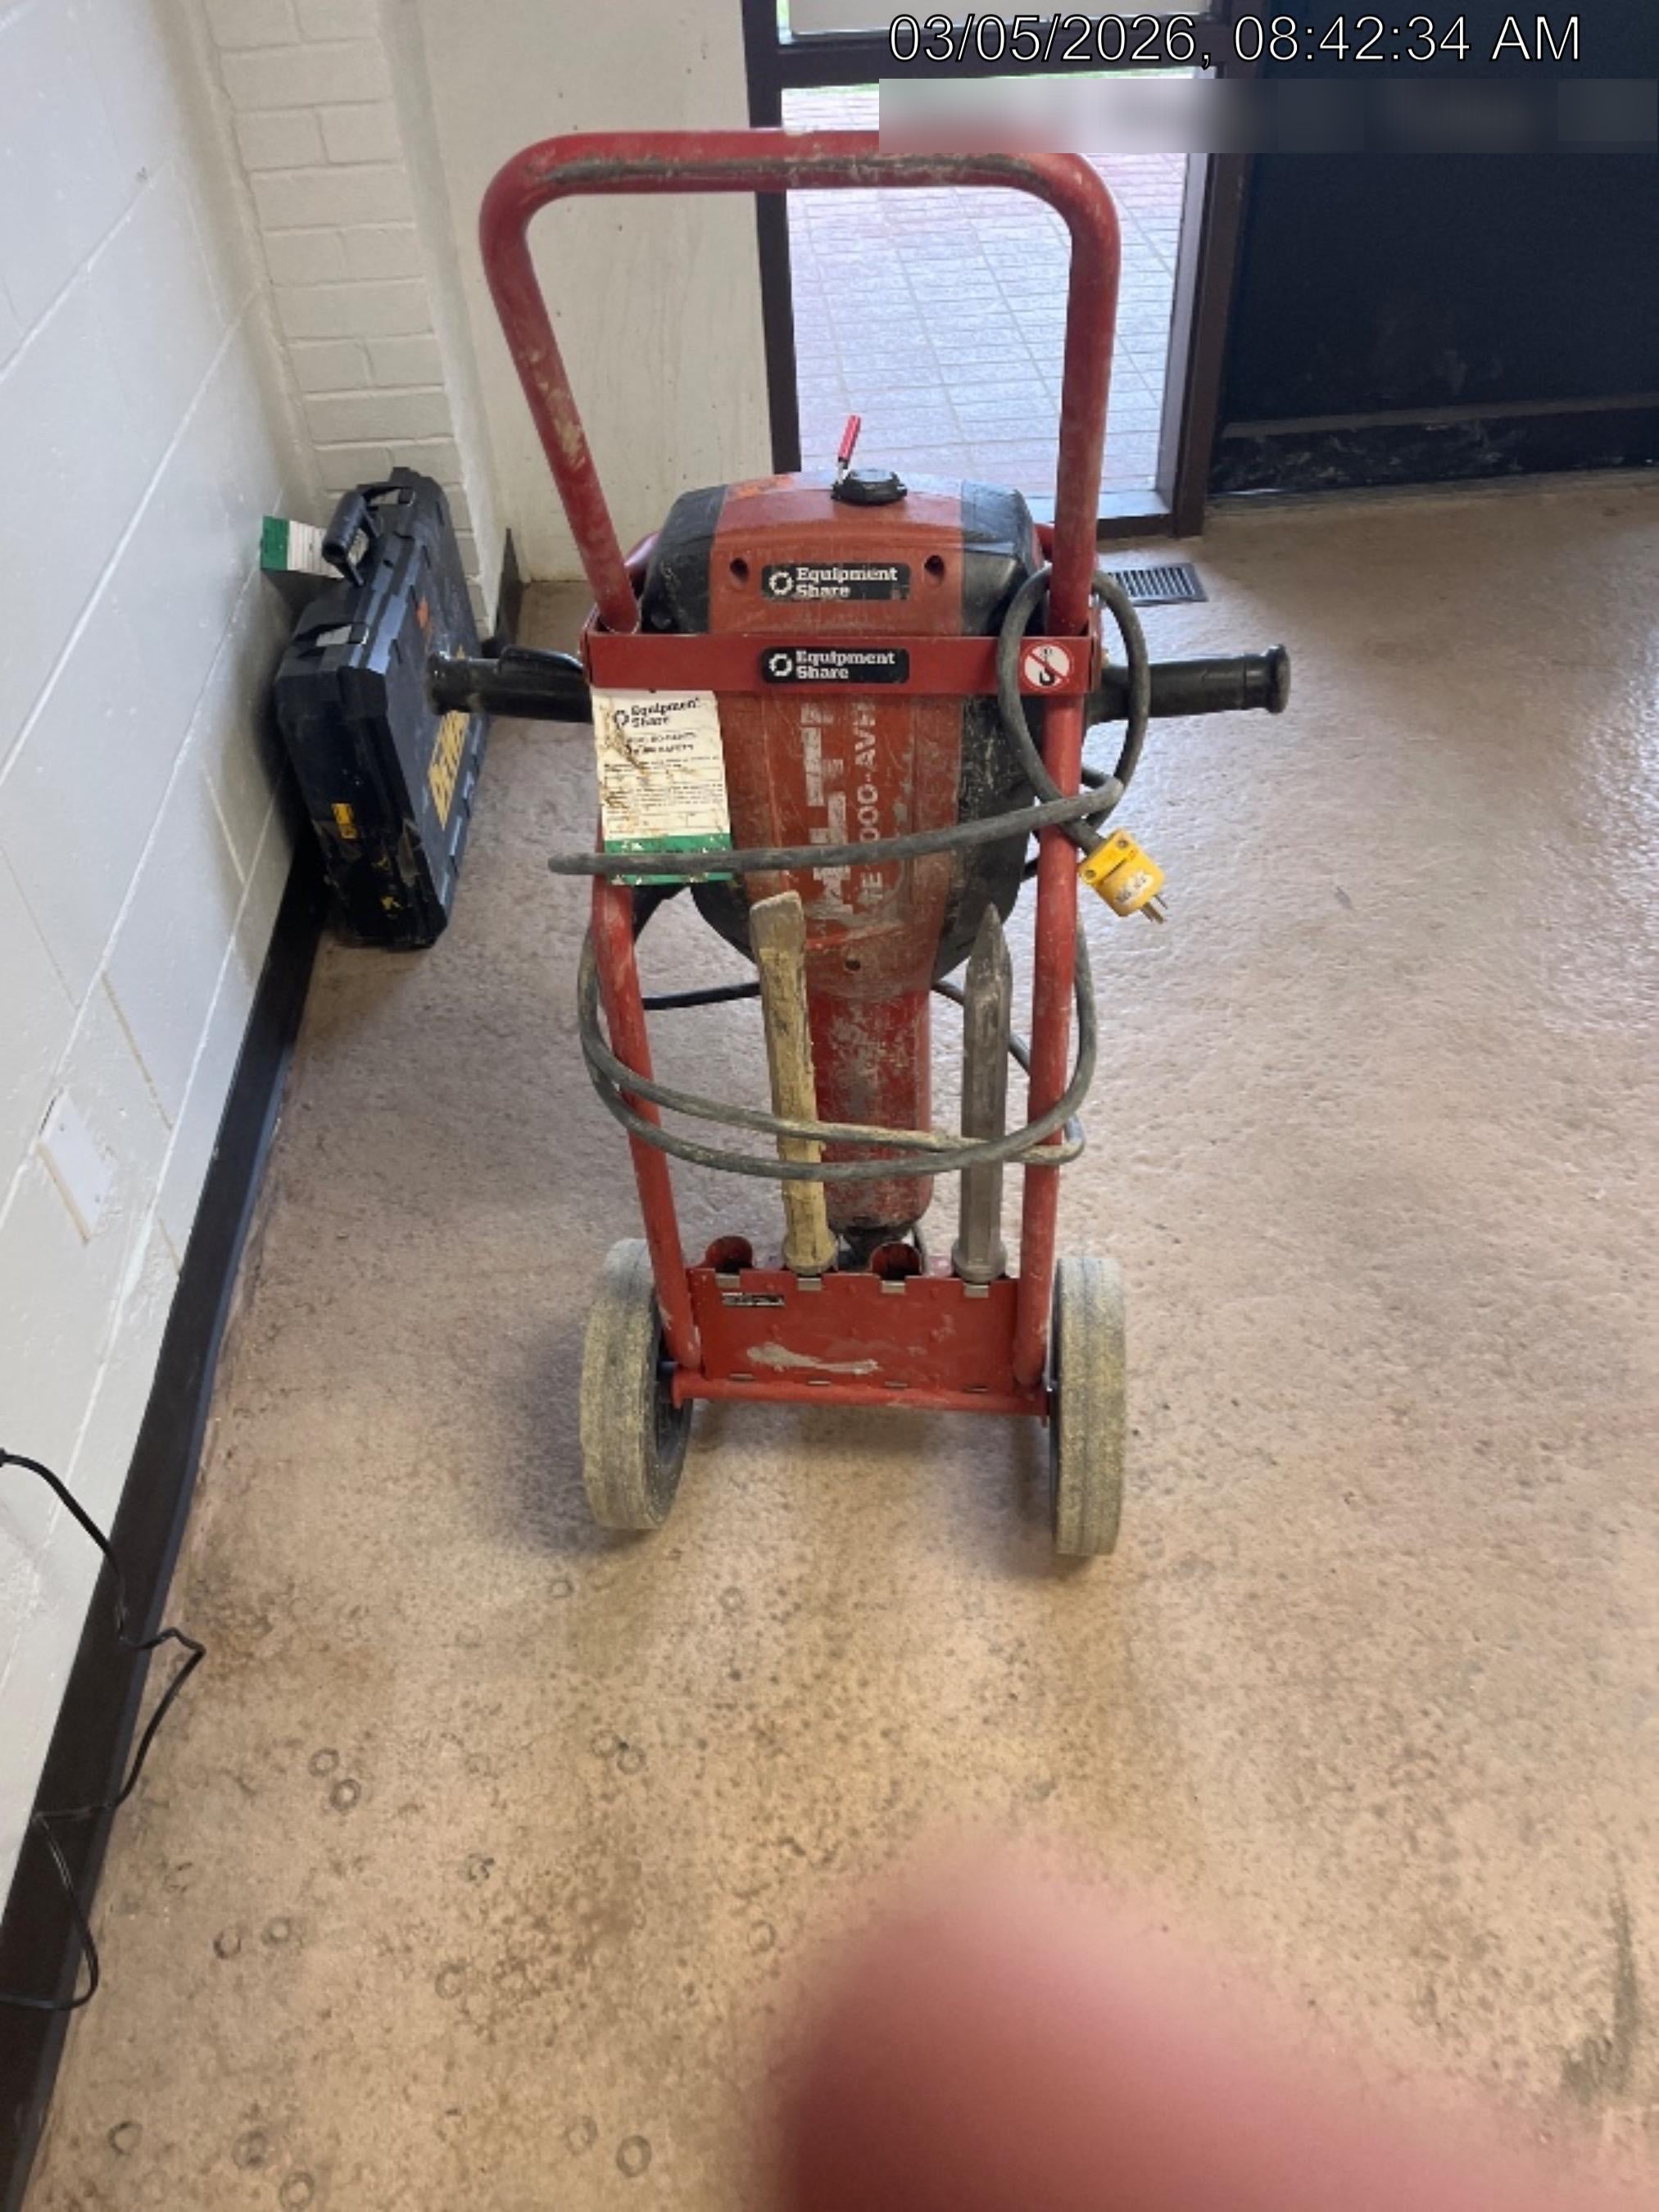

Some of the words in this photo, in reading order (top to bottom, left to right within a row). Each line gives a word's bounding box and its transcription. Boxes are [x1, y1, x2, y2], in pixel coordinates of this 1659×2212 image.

[796, 567, 898, 583] Equipment
[796, 584, 851, 598] Share
[796, 649, 895, 666] Equipment
[796, 665, 849, 679] Share
[801, 703, 853, 919] HLTI
